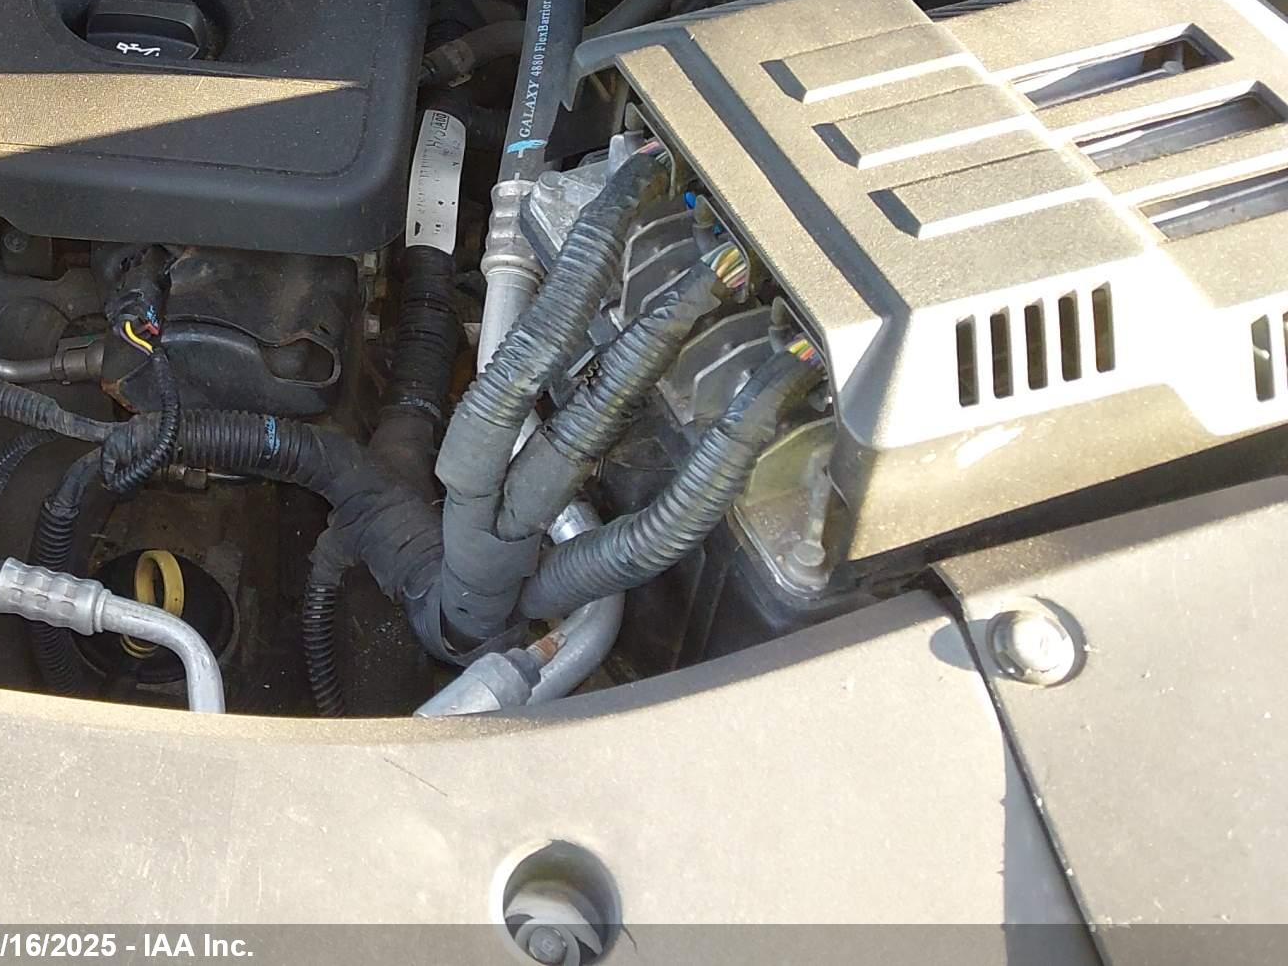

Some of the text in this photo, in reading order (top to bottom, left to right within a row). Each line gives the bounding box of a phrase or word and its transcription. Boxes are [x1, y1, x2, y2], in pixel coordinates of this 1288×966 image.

[534, 0, 552, 52] FlexBarrier
[531, 54, 545, 77] 4880
[519, 80, 540, 138] GALAXY
